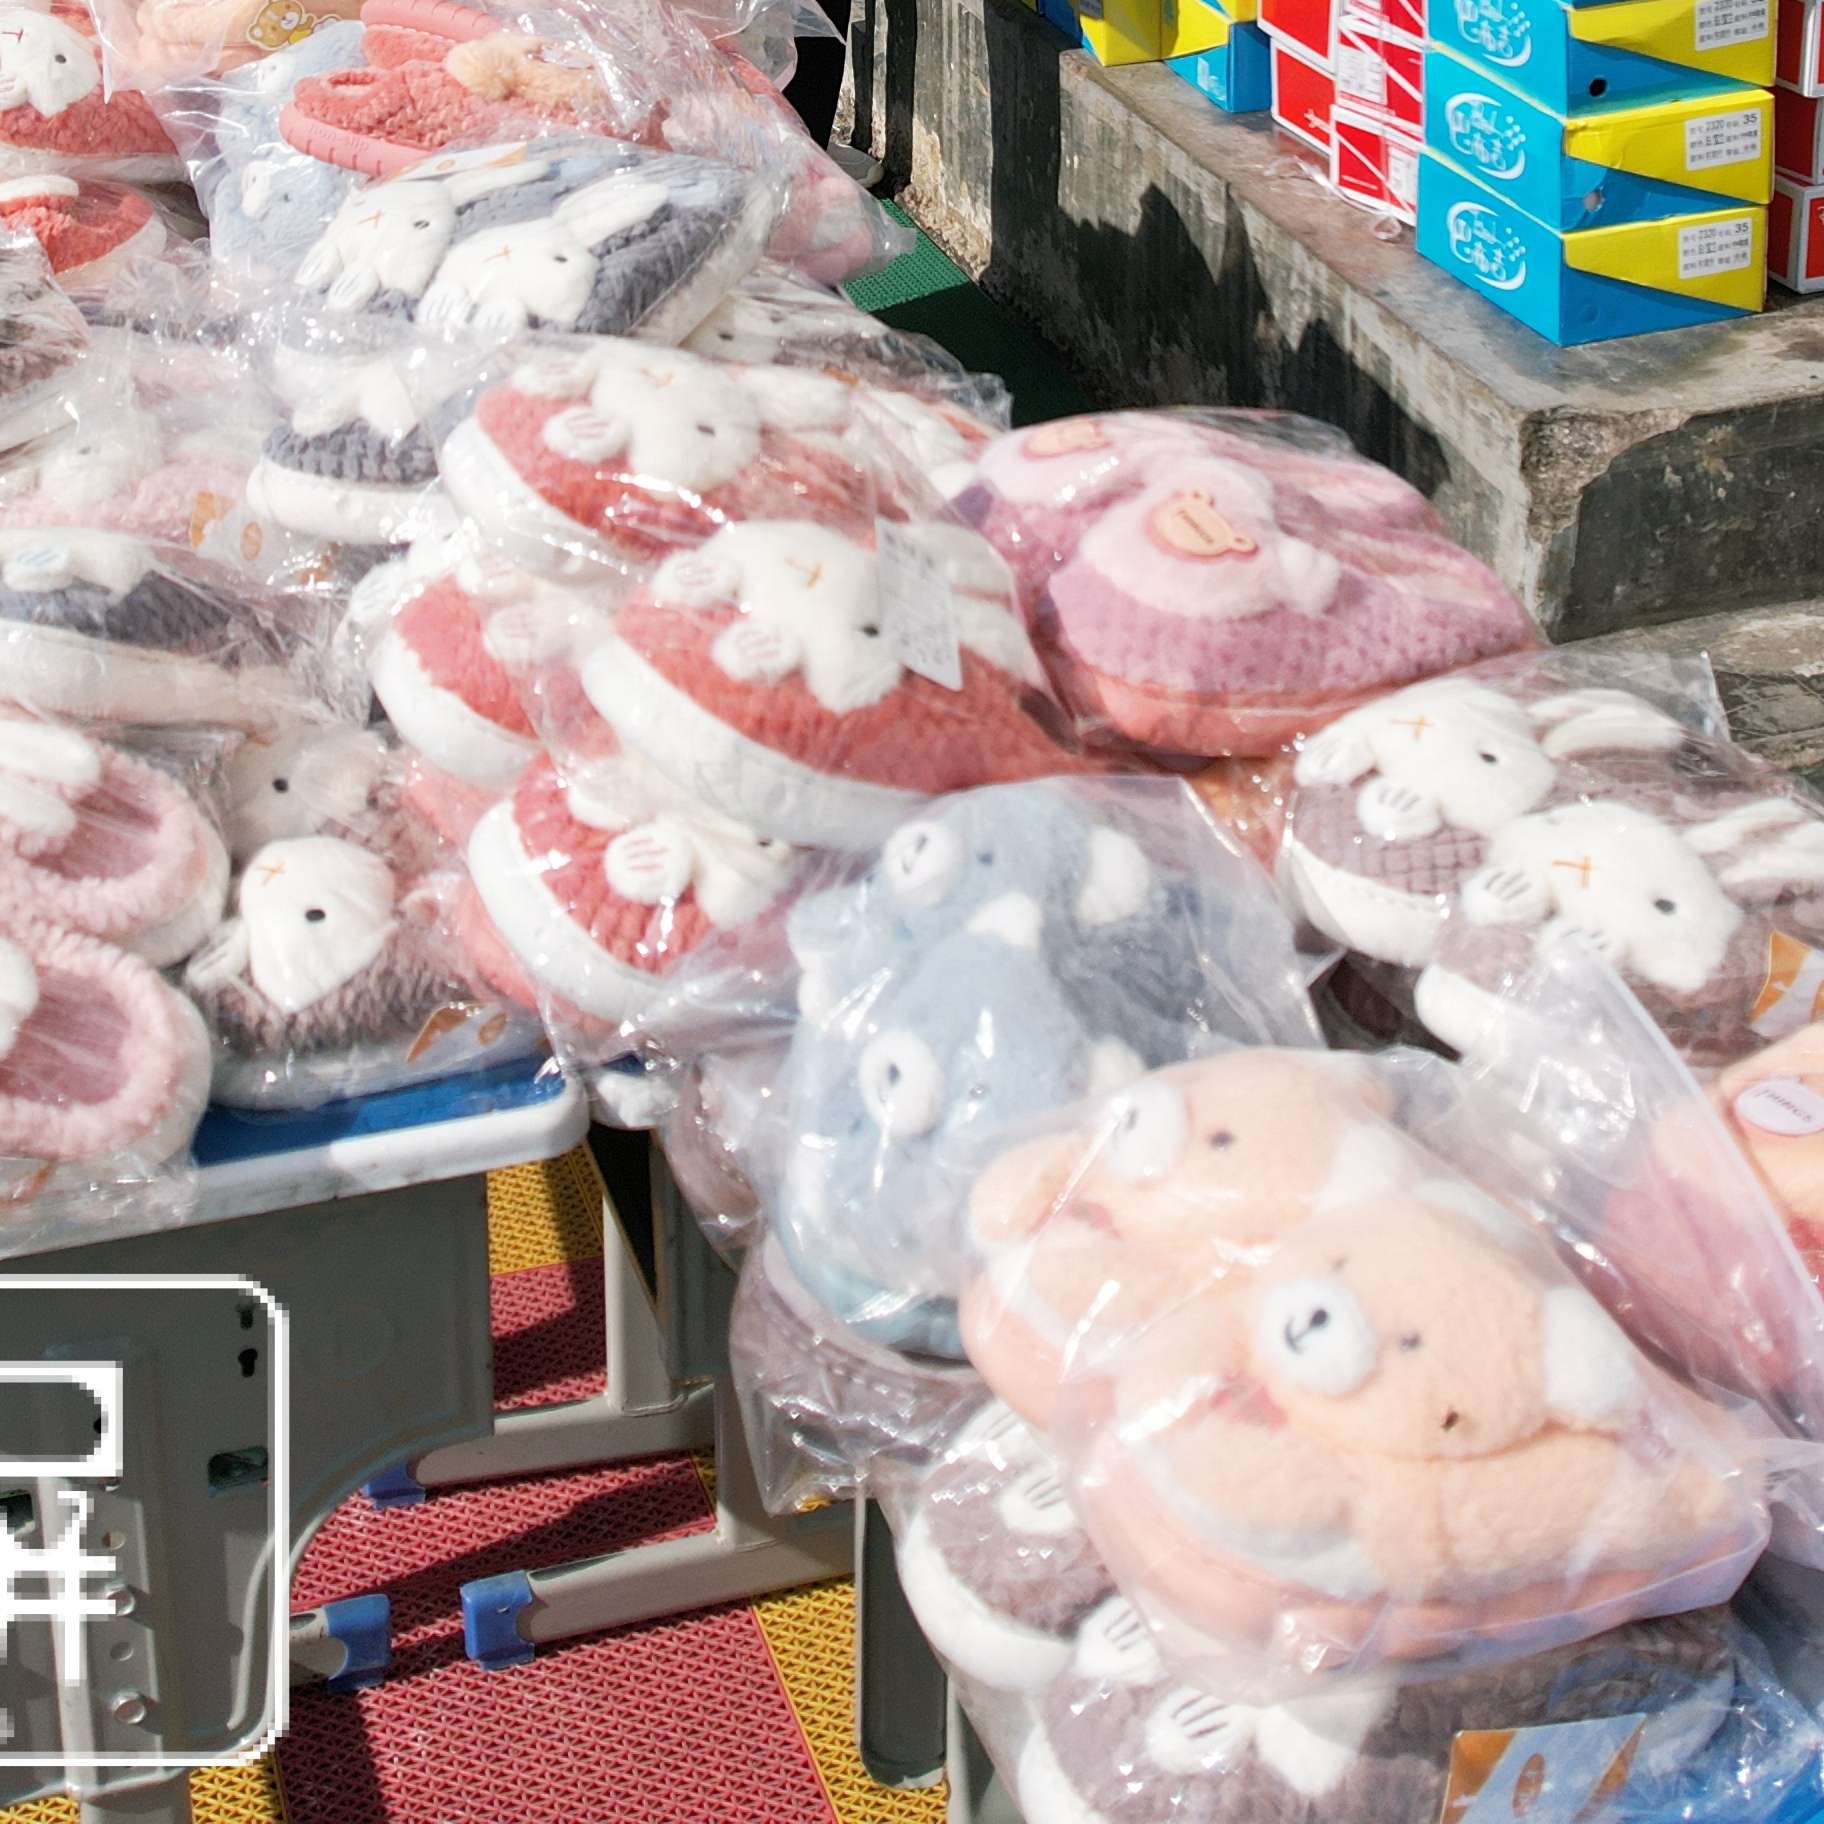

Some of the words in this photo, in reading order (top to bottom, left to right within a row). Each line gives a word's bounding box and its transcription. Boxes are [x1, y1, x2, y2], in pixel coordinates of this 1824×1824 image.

[1743, 114, 1757, 125] 35
[1736, 223, 1749, 234] 35
[1754, 1088, 1813, 1122] THINGS
